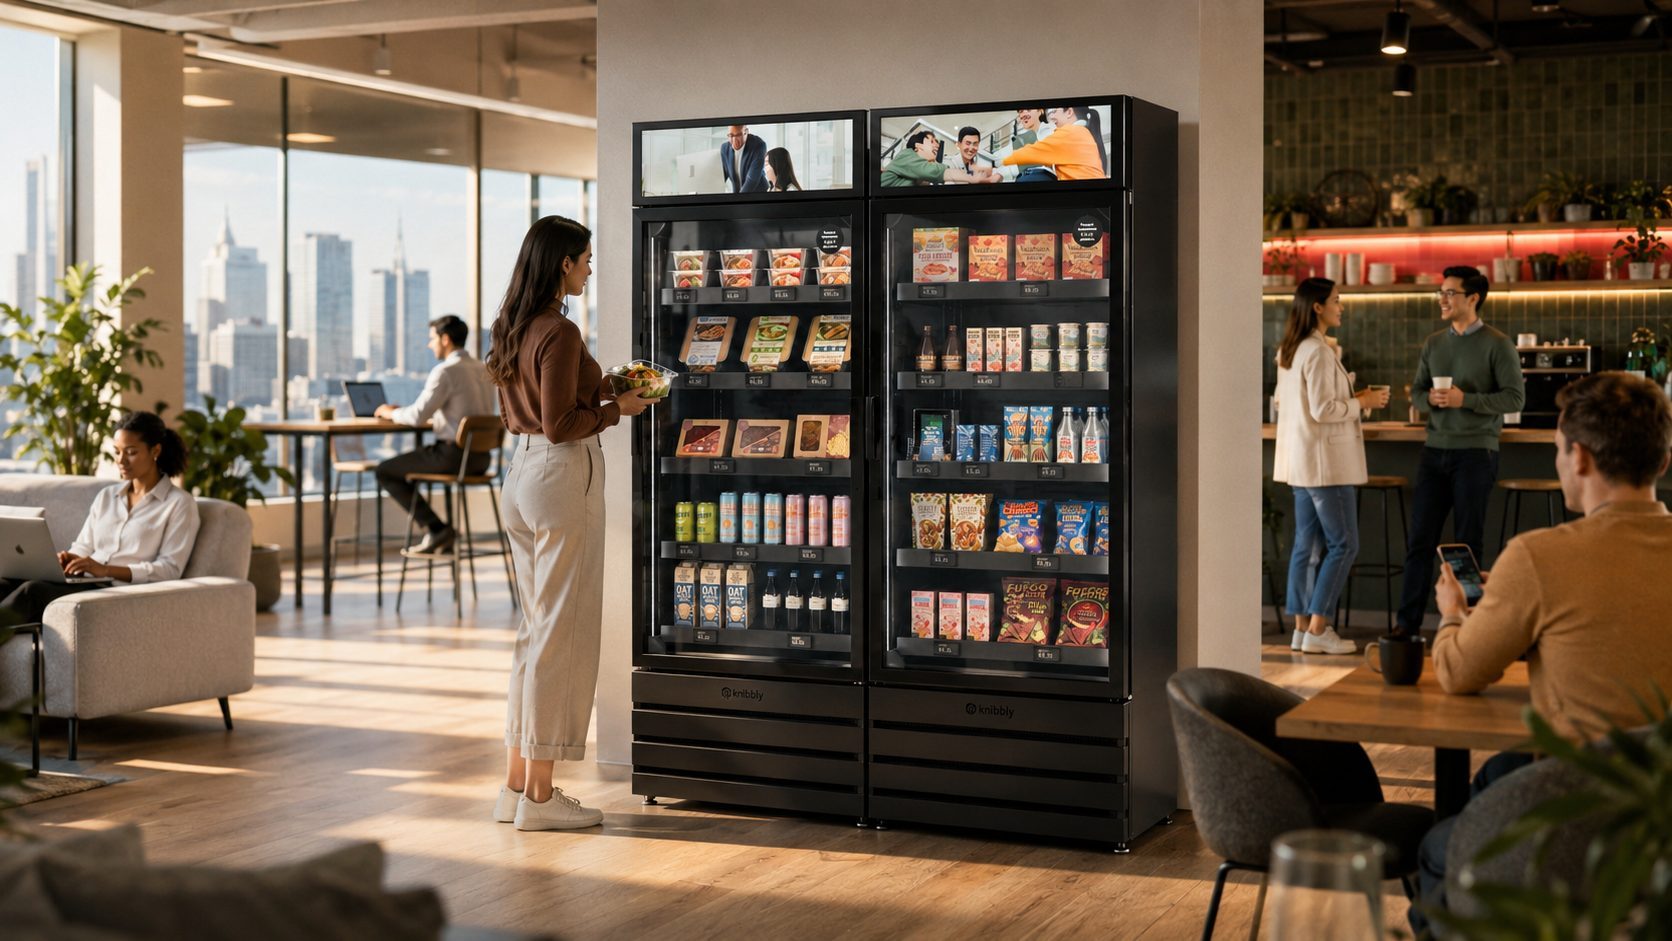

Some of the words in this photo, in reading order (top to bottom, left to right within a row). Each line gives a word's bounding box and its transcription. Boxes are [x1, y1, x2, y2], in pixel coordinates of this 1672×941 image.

[676, 585, 693, 596] OAT
[702, 586, 719, 596] OAT
[728, 586, 745, 597] OAT
[732, 689, 764, 702] knibbly
[979, 704, 1014, 719] knibbly
